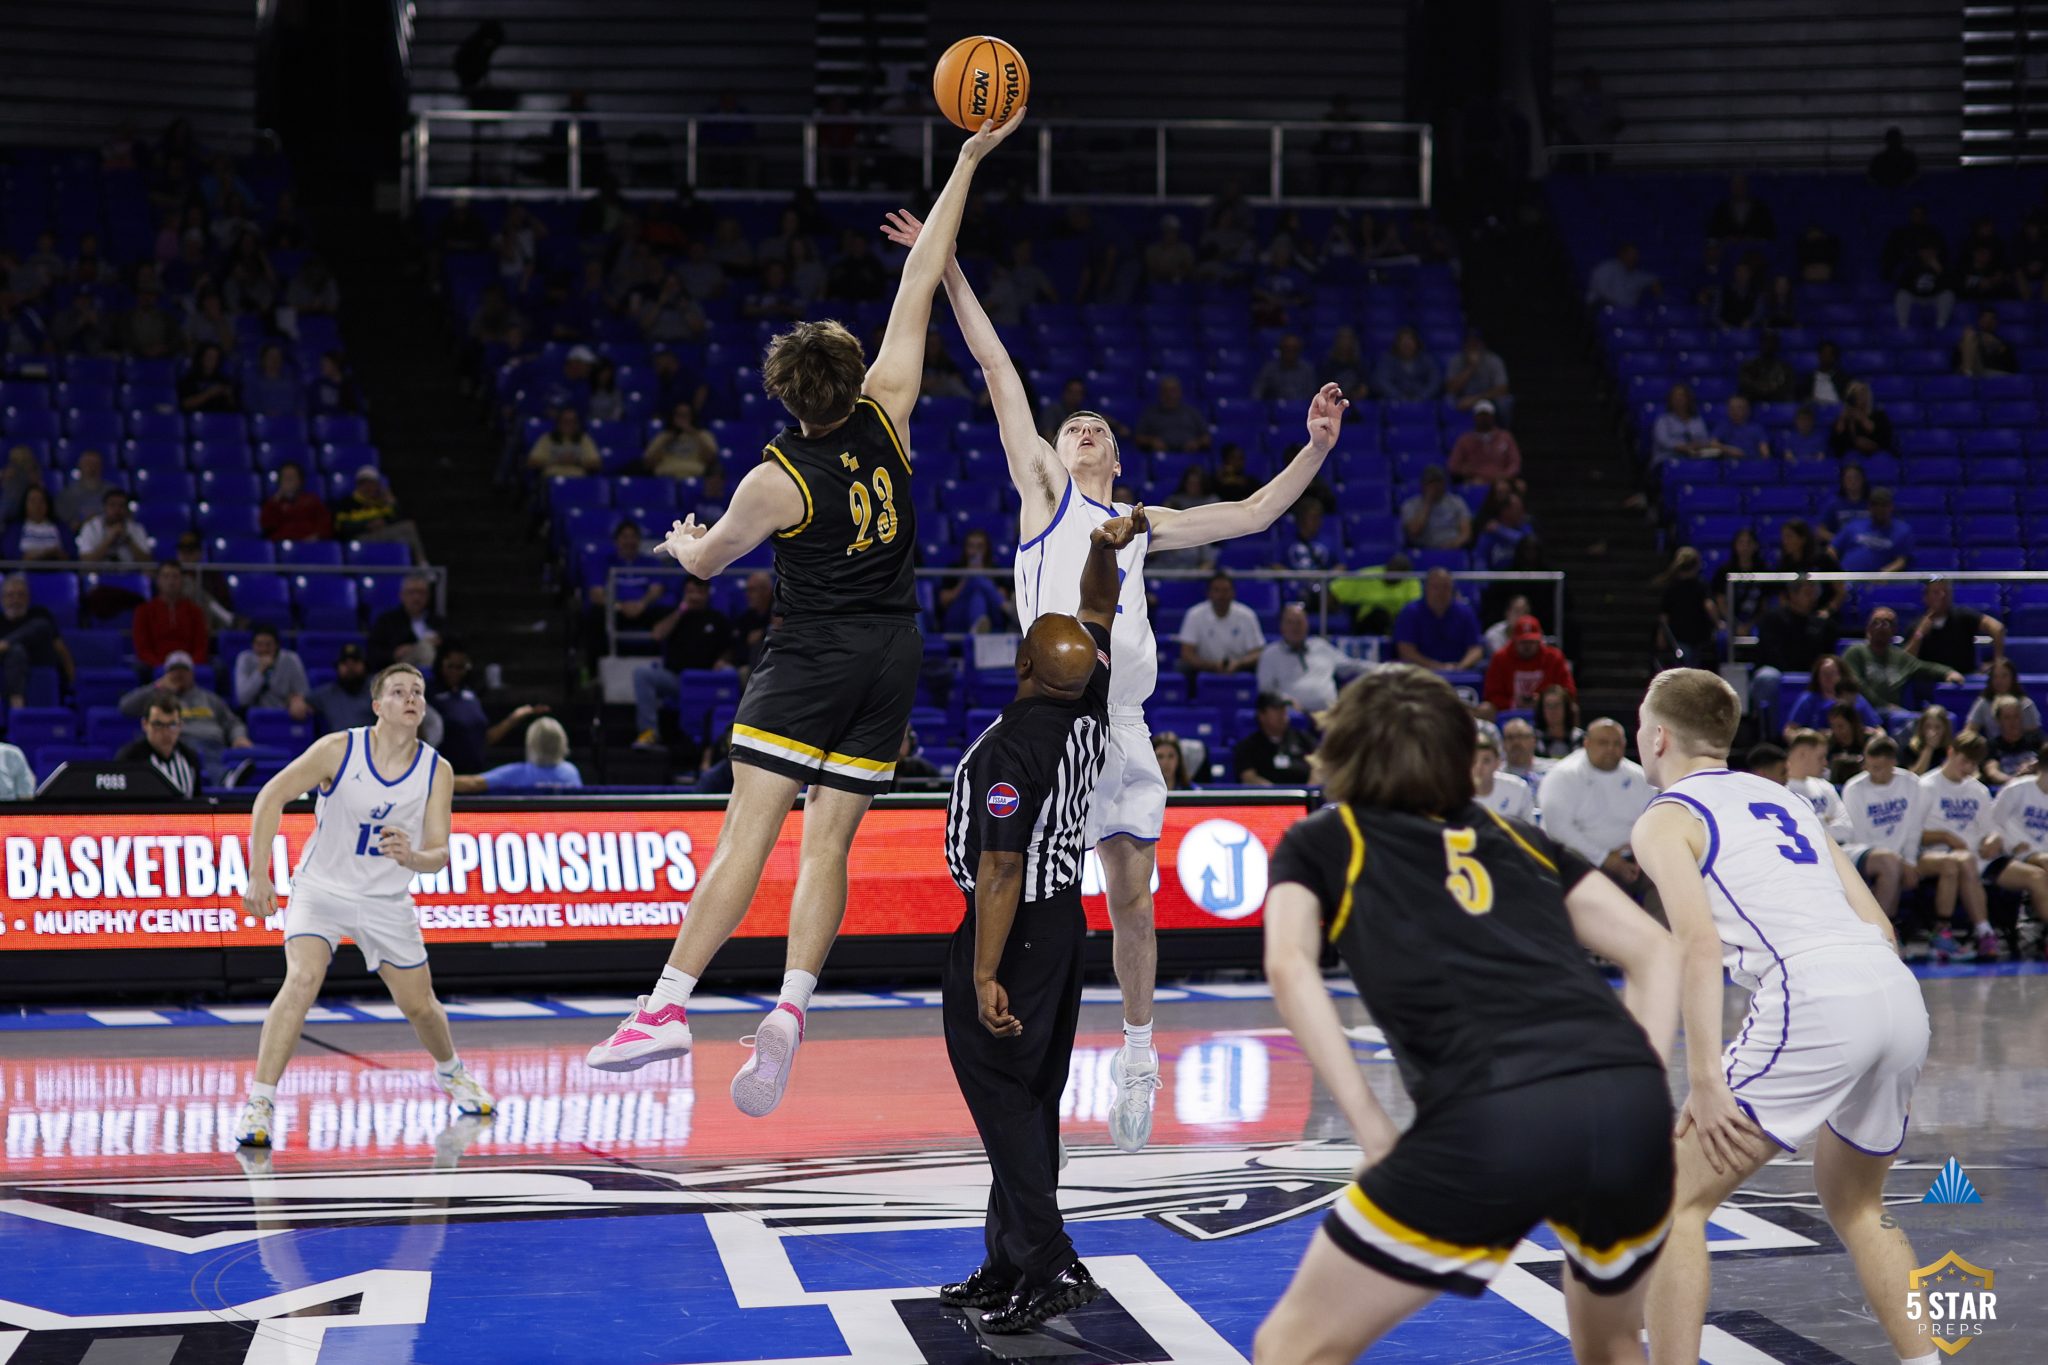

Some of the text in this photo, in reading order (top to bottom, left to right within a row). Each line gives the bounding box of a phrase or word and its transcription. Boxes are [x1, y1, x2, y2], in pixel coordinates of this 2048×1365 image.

[971, 68, 990, 116] NCAA
[997, 61, 1019, 122] Wilson
[847, 466, 898, 556] 23
[96, 774, 126, 790] POSS
[1748, 802, 1818, 864] 3
[5, 830, 697, 899] BASKETBAL PIONSHIPS
[1442, 826, 1494, 915] 5
[34, 909, 138, 934] MURPHY
[140, 907, 237, 932] CENTER
[413, 904, 492, 929] ESSEE
[493, 903, 564, 928] STATE
